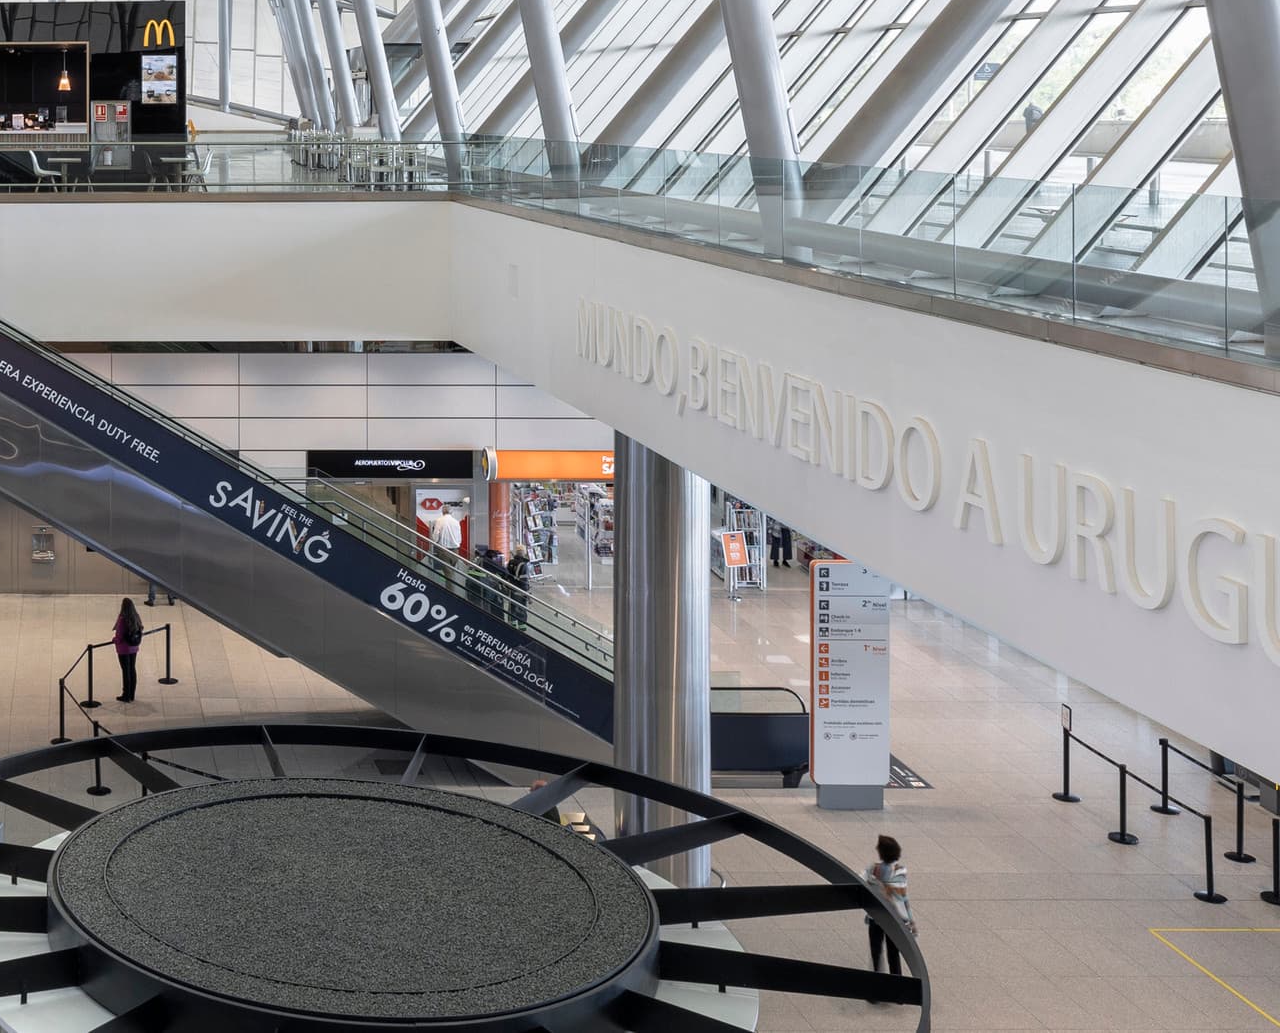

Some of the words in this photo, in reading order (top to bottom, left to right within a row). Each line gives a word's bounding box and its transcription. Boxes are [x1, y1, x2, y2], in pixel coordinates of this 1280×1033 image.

[22, 374, 95, 427] EXPERIENCIA
[97, 418, 132, 444] DUTY
[130, 437, 160, 464] FREE.
[208, 480, 332, 564] SAVING
[280, 503, 298, 519] FEEL
[299, 513, 314, 527] THE
[953, 438, 1005, 547] A
[396, 568, 427, 593] Hasta
[380, 581, 459, 643] 60%
[459, 633, 473, 648] VS.
[474, 644, 522, 676] MERCADO
[523, 670, 554, 694] LOCAL
[464, 624, 474, 635] en
[476, 629, 532, 668] PERFUMERÍA
